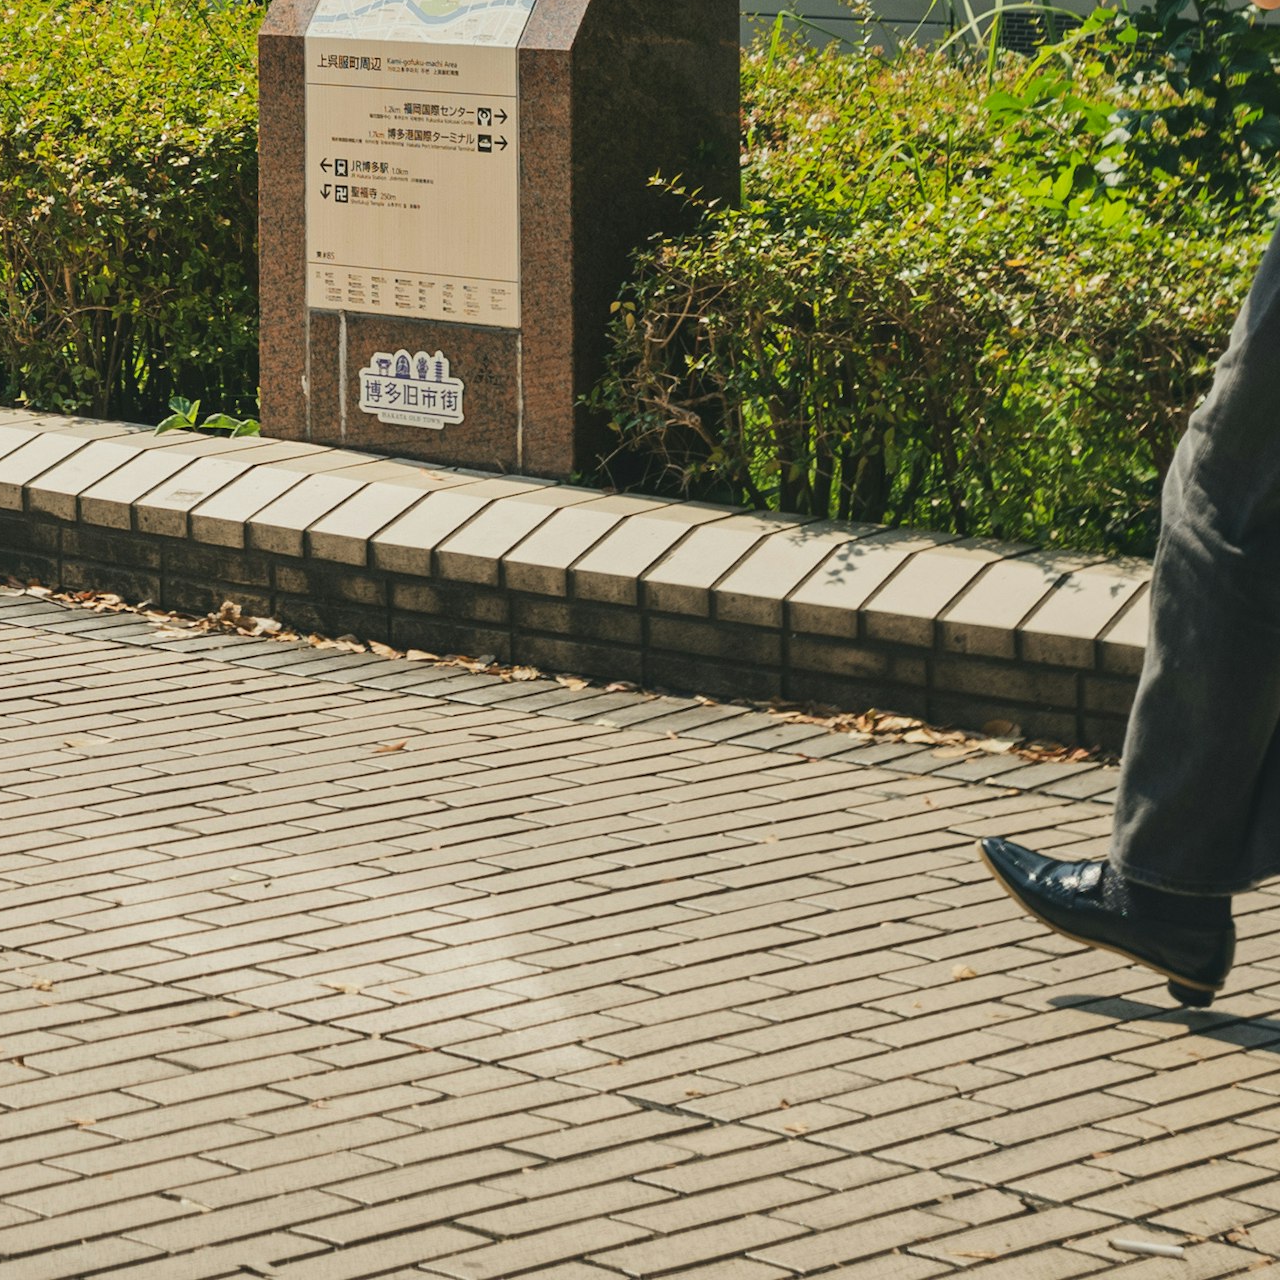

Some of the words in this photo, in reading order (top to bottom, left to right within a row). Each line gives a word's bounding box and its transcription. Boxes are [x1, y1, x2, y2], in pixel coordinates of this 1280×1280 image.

[317, 54, 381, 71] 上呉服町周辺
[387, 57, 443, 67] Kami-gofuku-machi
[404, 103, 474, 117] 福岡国際センター
[388, 128, 474, 145] 博多港国際ターミナル
[351, 161, 389, 173] JR博多駅
[351, 186, 377, 199] 聖福寺
[380, 192, 396, 200] 250m
[365, 379, 458, 412] 博多旧市街
[382, 412, 407, 420] HAKATA
